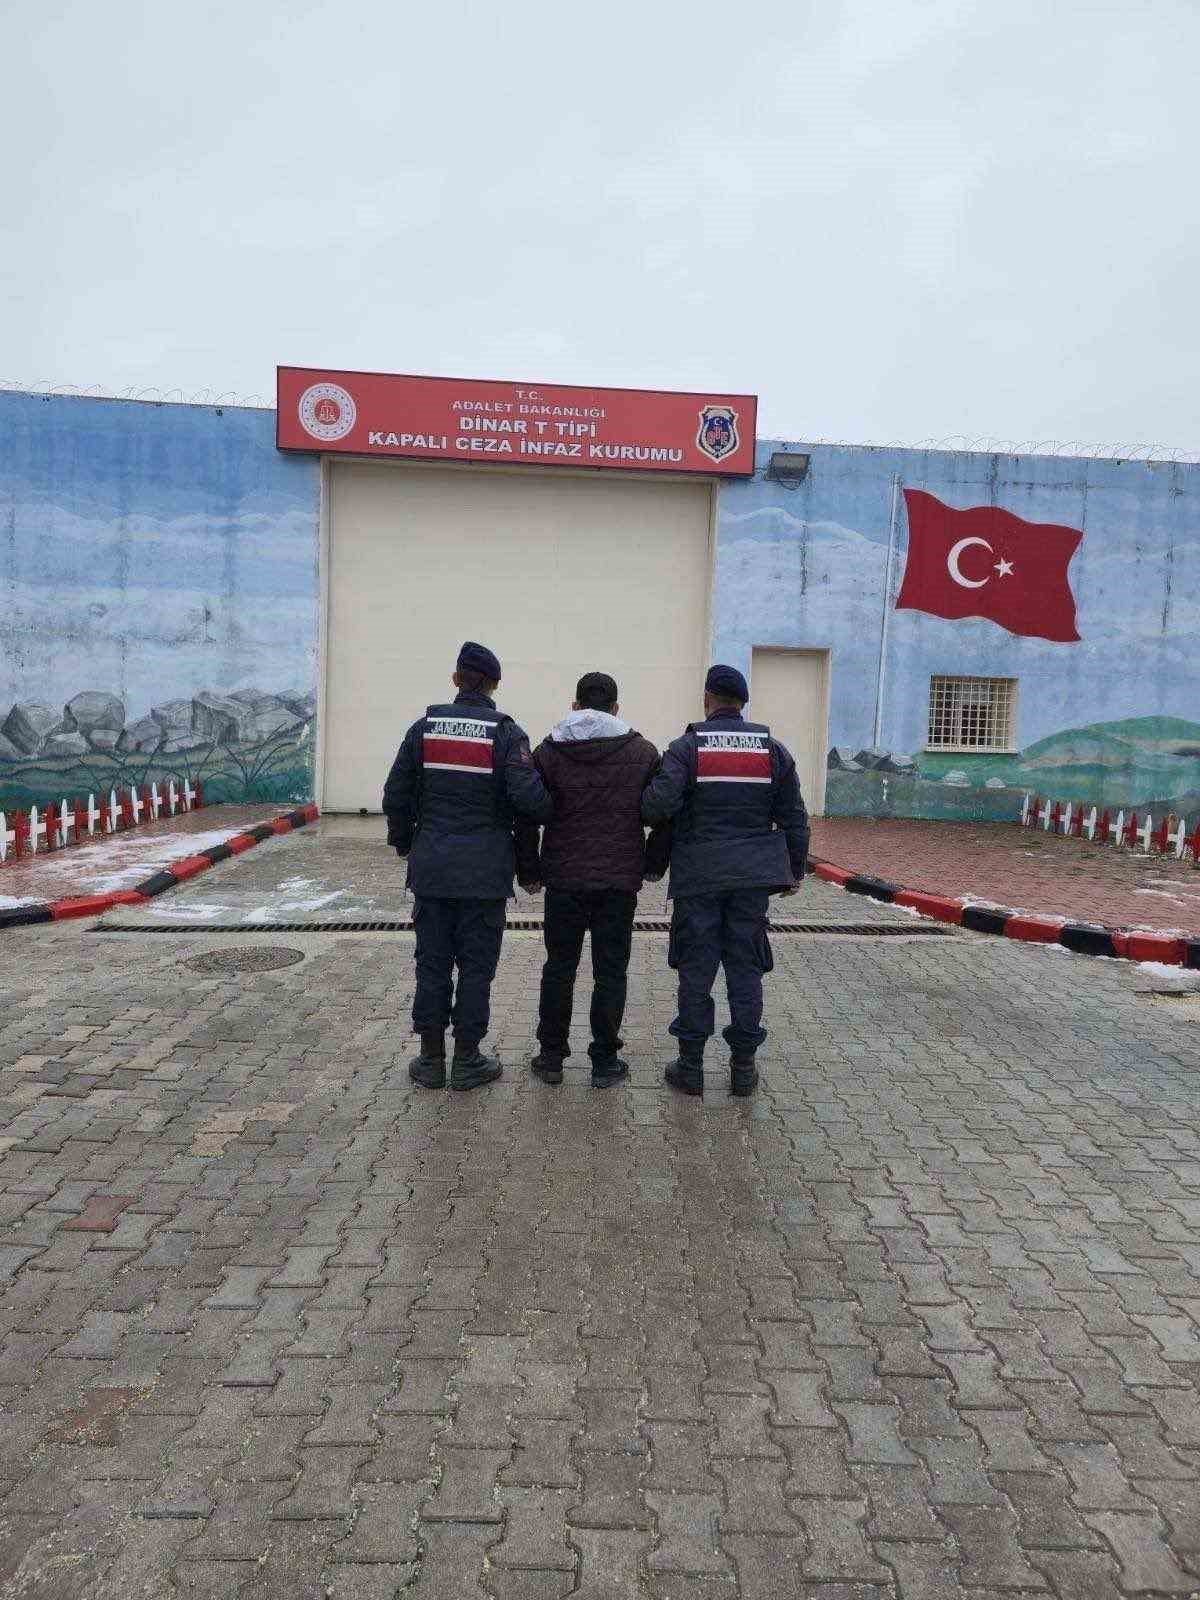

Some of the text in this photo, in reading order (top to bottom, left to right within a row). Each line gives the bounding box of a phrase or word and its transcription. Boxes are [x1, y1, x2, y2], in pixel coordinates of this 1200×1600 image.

[515, 390, 544, 400] T.C.
[452, 401, 514, 412] ADALET
[459, 415, 597, 437] DİNAR T TİPİ
[368, 431, 683, 462] KAPALI CEZA İNFAZ KURUMU
[431, 720, 487, 738] JANDARMA
[704, 734, 763, 749] JANDARMA
